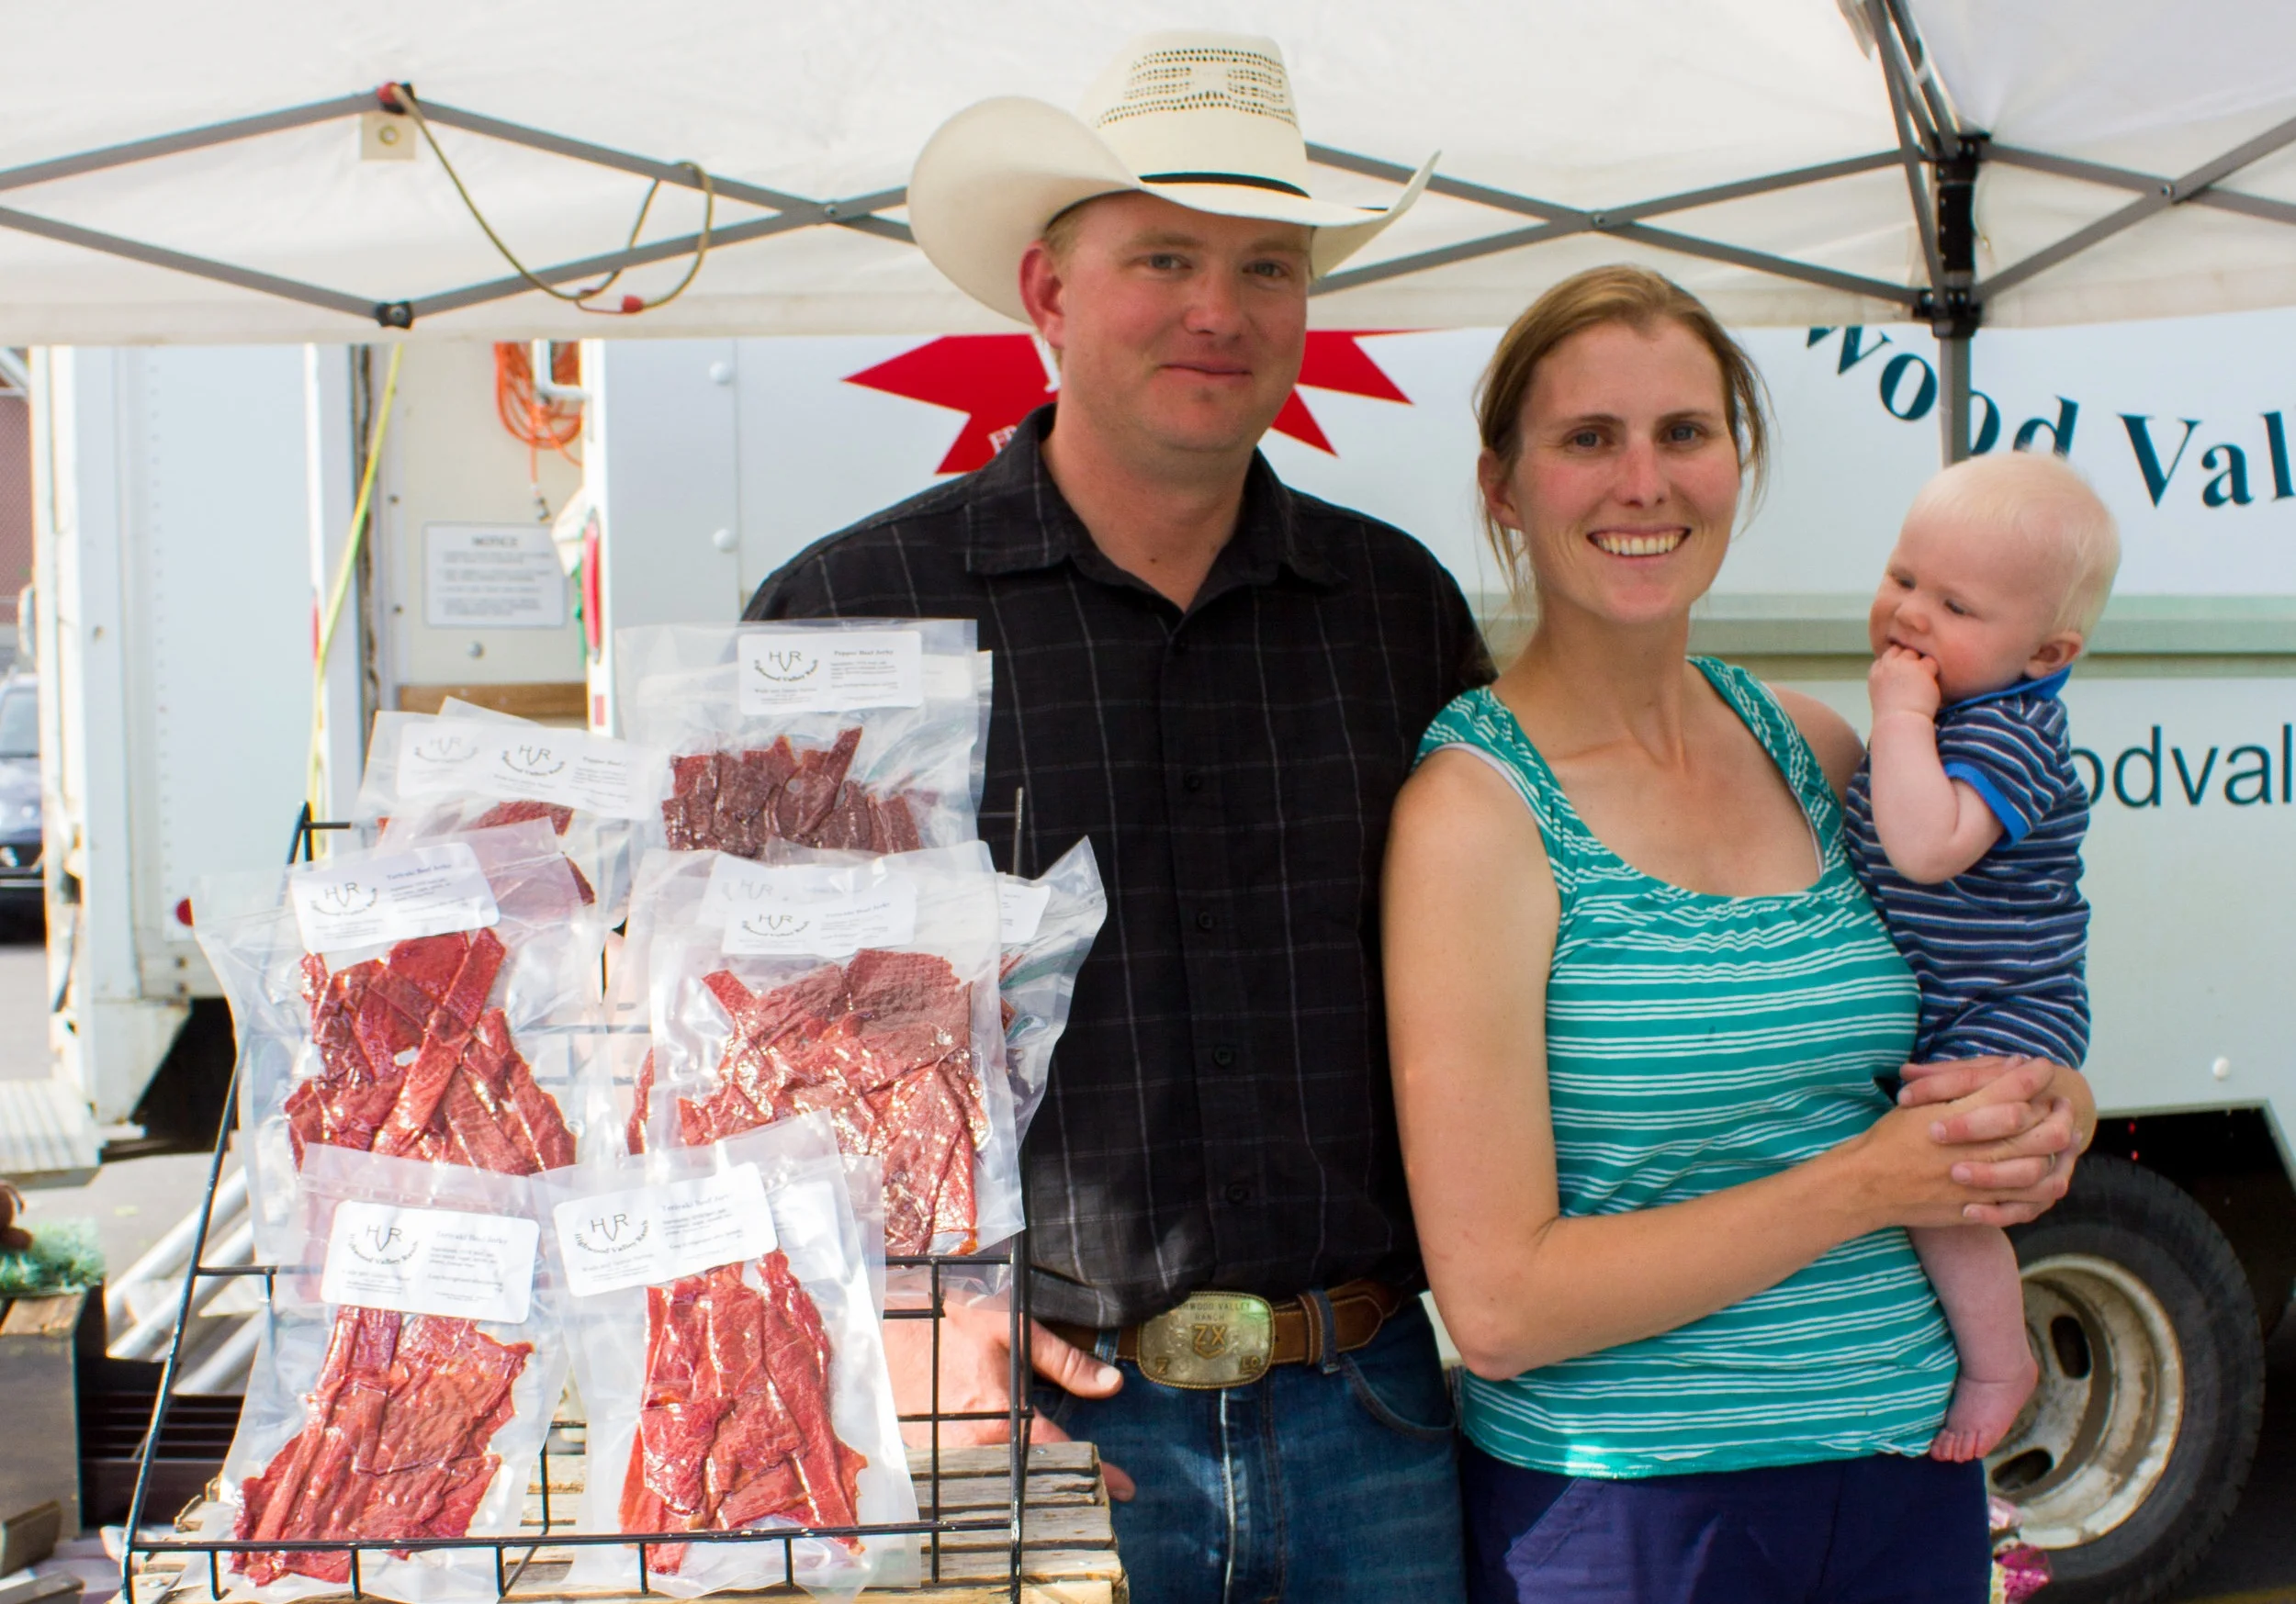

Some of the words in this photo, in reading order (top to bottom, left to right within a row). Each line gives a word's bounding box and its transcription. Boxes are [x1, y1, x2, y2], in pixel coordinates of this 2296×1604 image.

[2116, 409, 2295, 510] Val
[1195, 1313, 1225, 1321] RANCH
[1194, 1325, 1226, 1346] ZX
